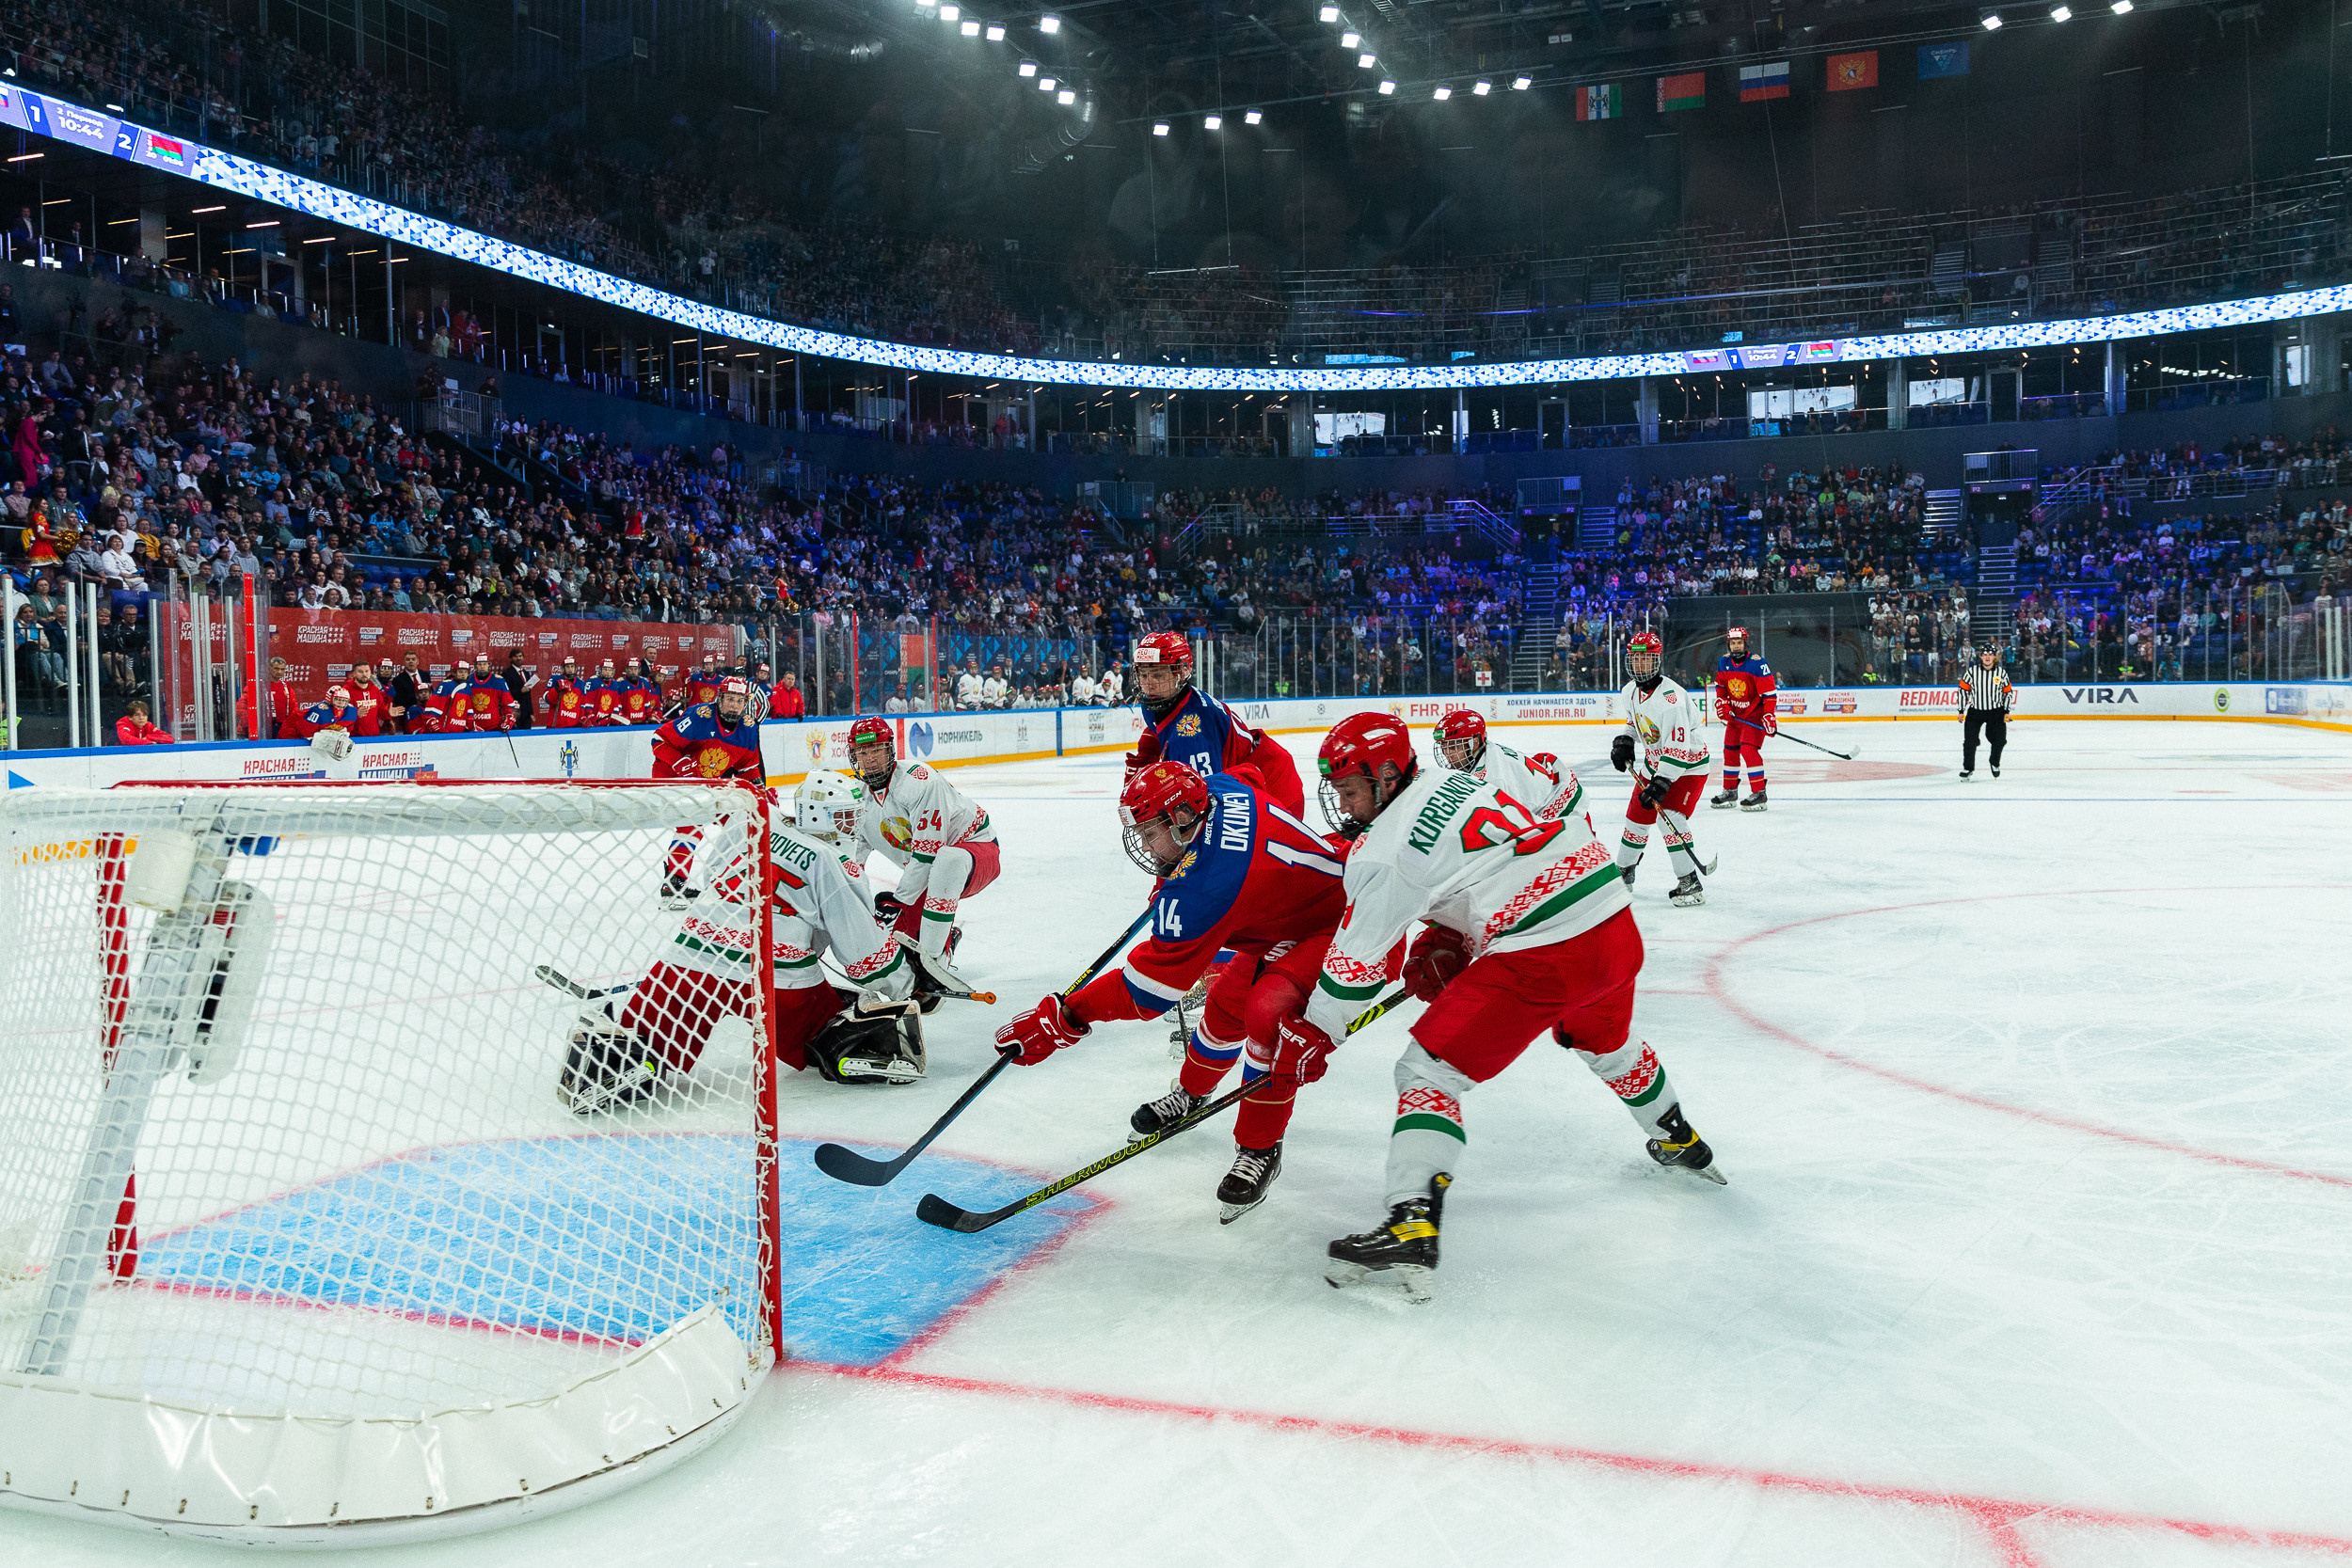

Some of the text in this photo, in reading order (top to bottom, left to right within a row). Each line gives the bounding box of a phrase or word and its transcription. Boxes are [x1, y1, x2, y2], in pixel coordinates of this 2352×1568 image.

[30, 105, 40, 122] 1
[66, 111, 103, 128] Период
[57, 116, 104, 140] 10:44
[118, 133, 133, 150] 2
[1730, 355, 1738, 363] 1
[1748, 353, 1777, 362] 10:44
[1786, 351, 1797, 359] 2
[297, 626, 329, 634] КРАСНАЯ
[398, 628, 425, 637] КРАСНАЯ
[296, 634, 328, 643] МАШИНА
[397, 636, 424, 645] МАШИНА
[1506, 698, 1532, 706] ХОККЕЙ
[1575, 697, 1597, 705] ЗДЕСЬ
[2061, 688, 2139, 704] VIRA
[1517, 708, 1586, 719] JUNIOR.FHR.RU
[938, 730, 983, 744] НОРНИКЕЛЬ
[1672, 726, 1685, 743] 13
[244, 758, 295, 774] КРАСНАЯ
[362, 752, 408, 768] КРАСНАЯ
[1189, 752, 1214, 778] 13
[1164, 790, 1182, 806] CCM
[1158, 897, 1183, 938] 14
[1025, 1131, 1161, 1208] SHERWOOD
